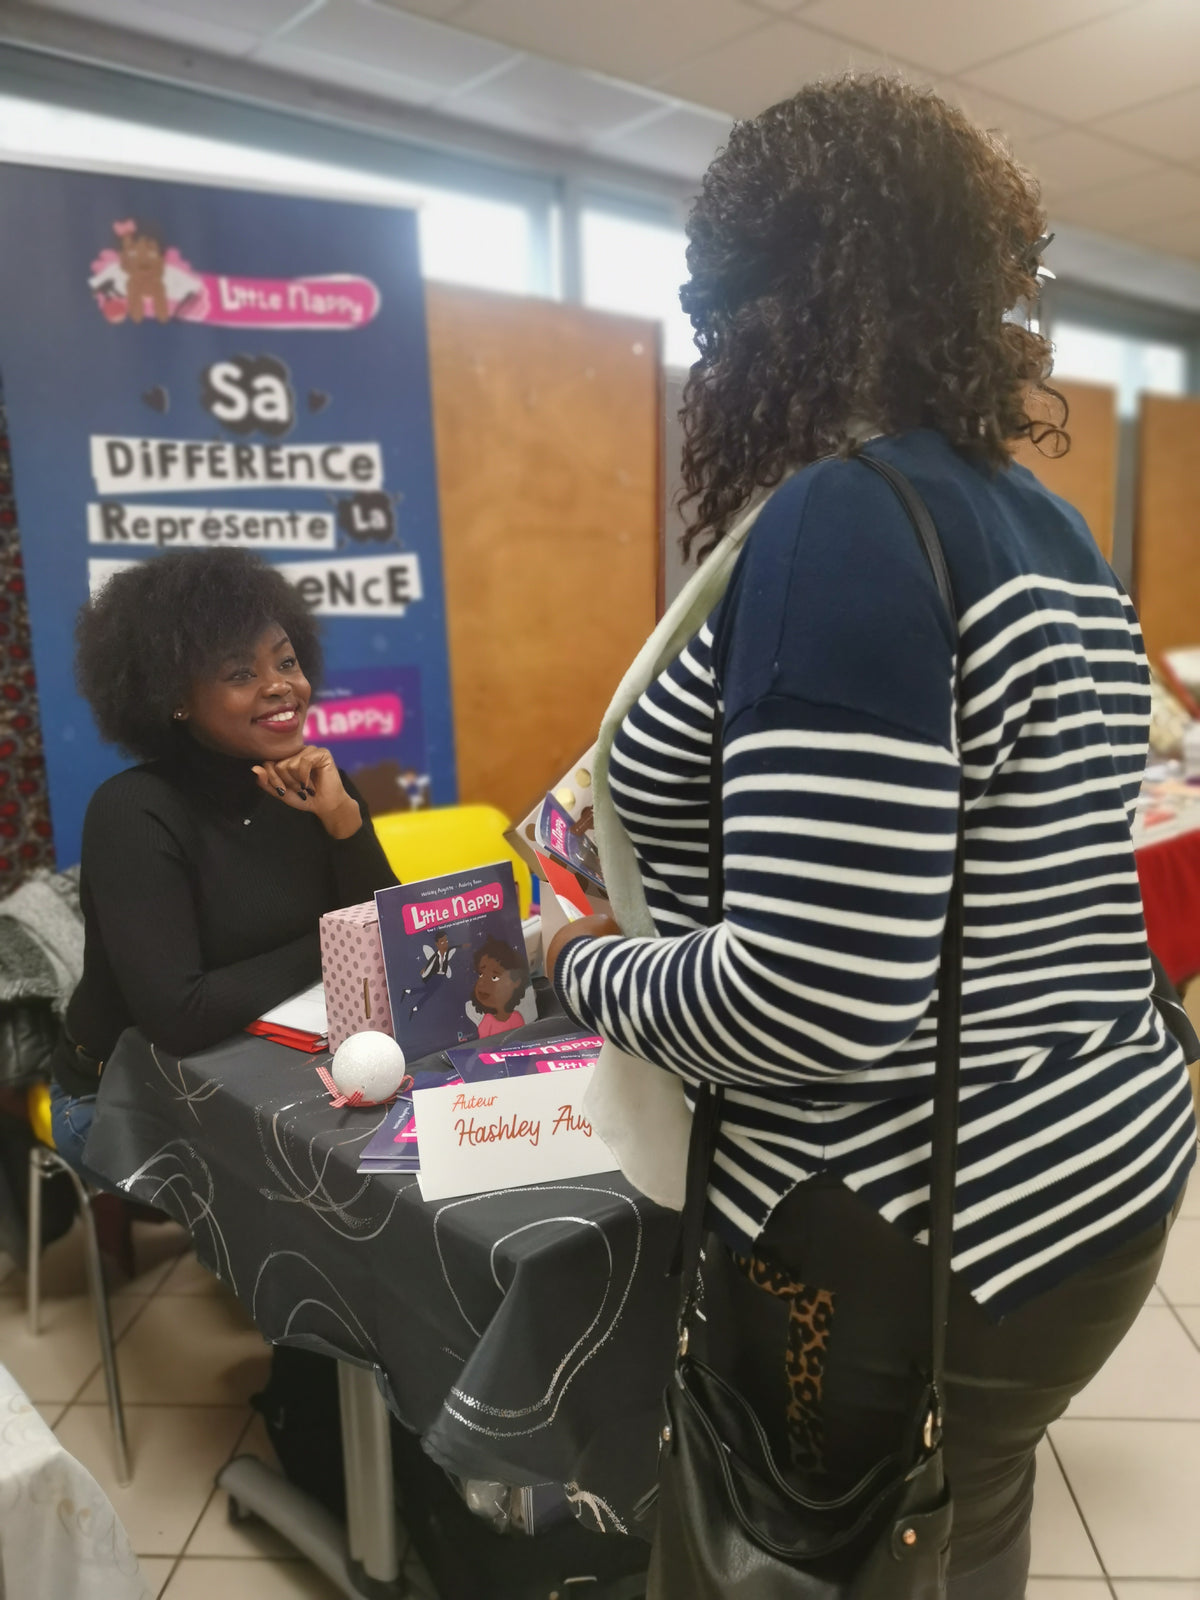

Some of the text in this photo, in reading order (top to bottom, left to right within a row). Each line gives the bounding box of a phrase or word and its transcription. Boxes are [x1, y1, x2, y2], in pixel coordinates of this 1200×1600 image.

[208, 361, 291, 423] Sa
[351, 503, 388, 533] La
[411, 906, 449, 931] Little
[452, 1093, 499, 1112] Auteur
[454, 1104, 593, 1147] Hashley Aug
